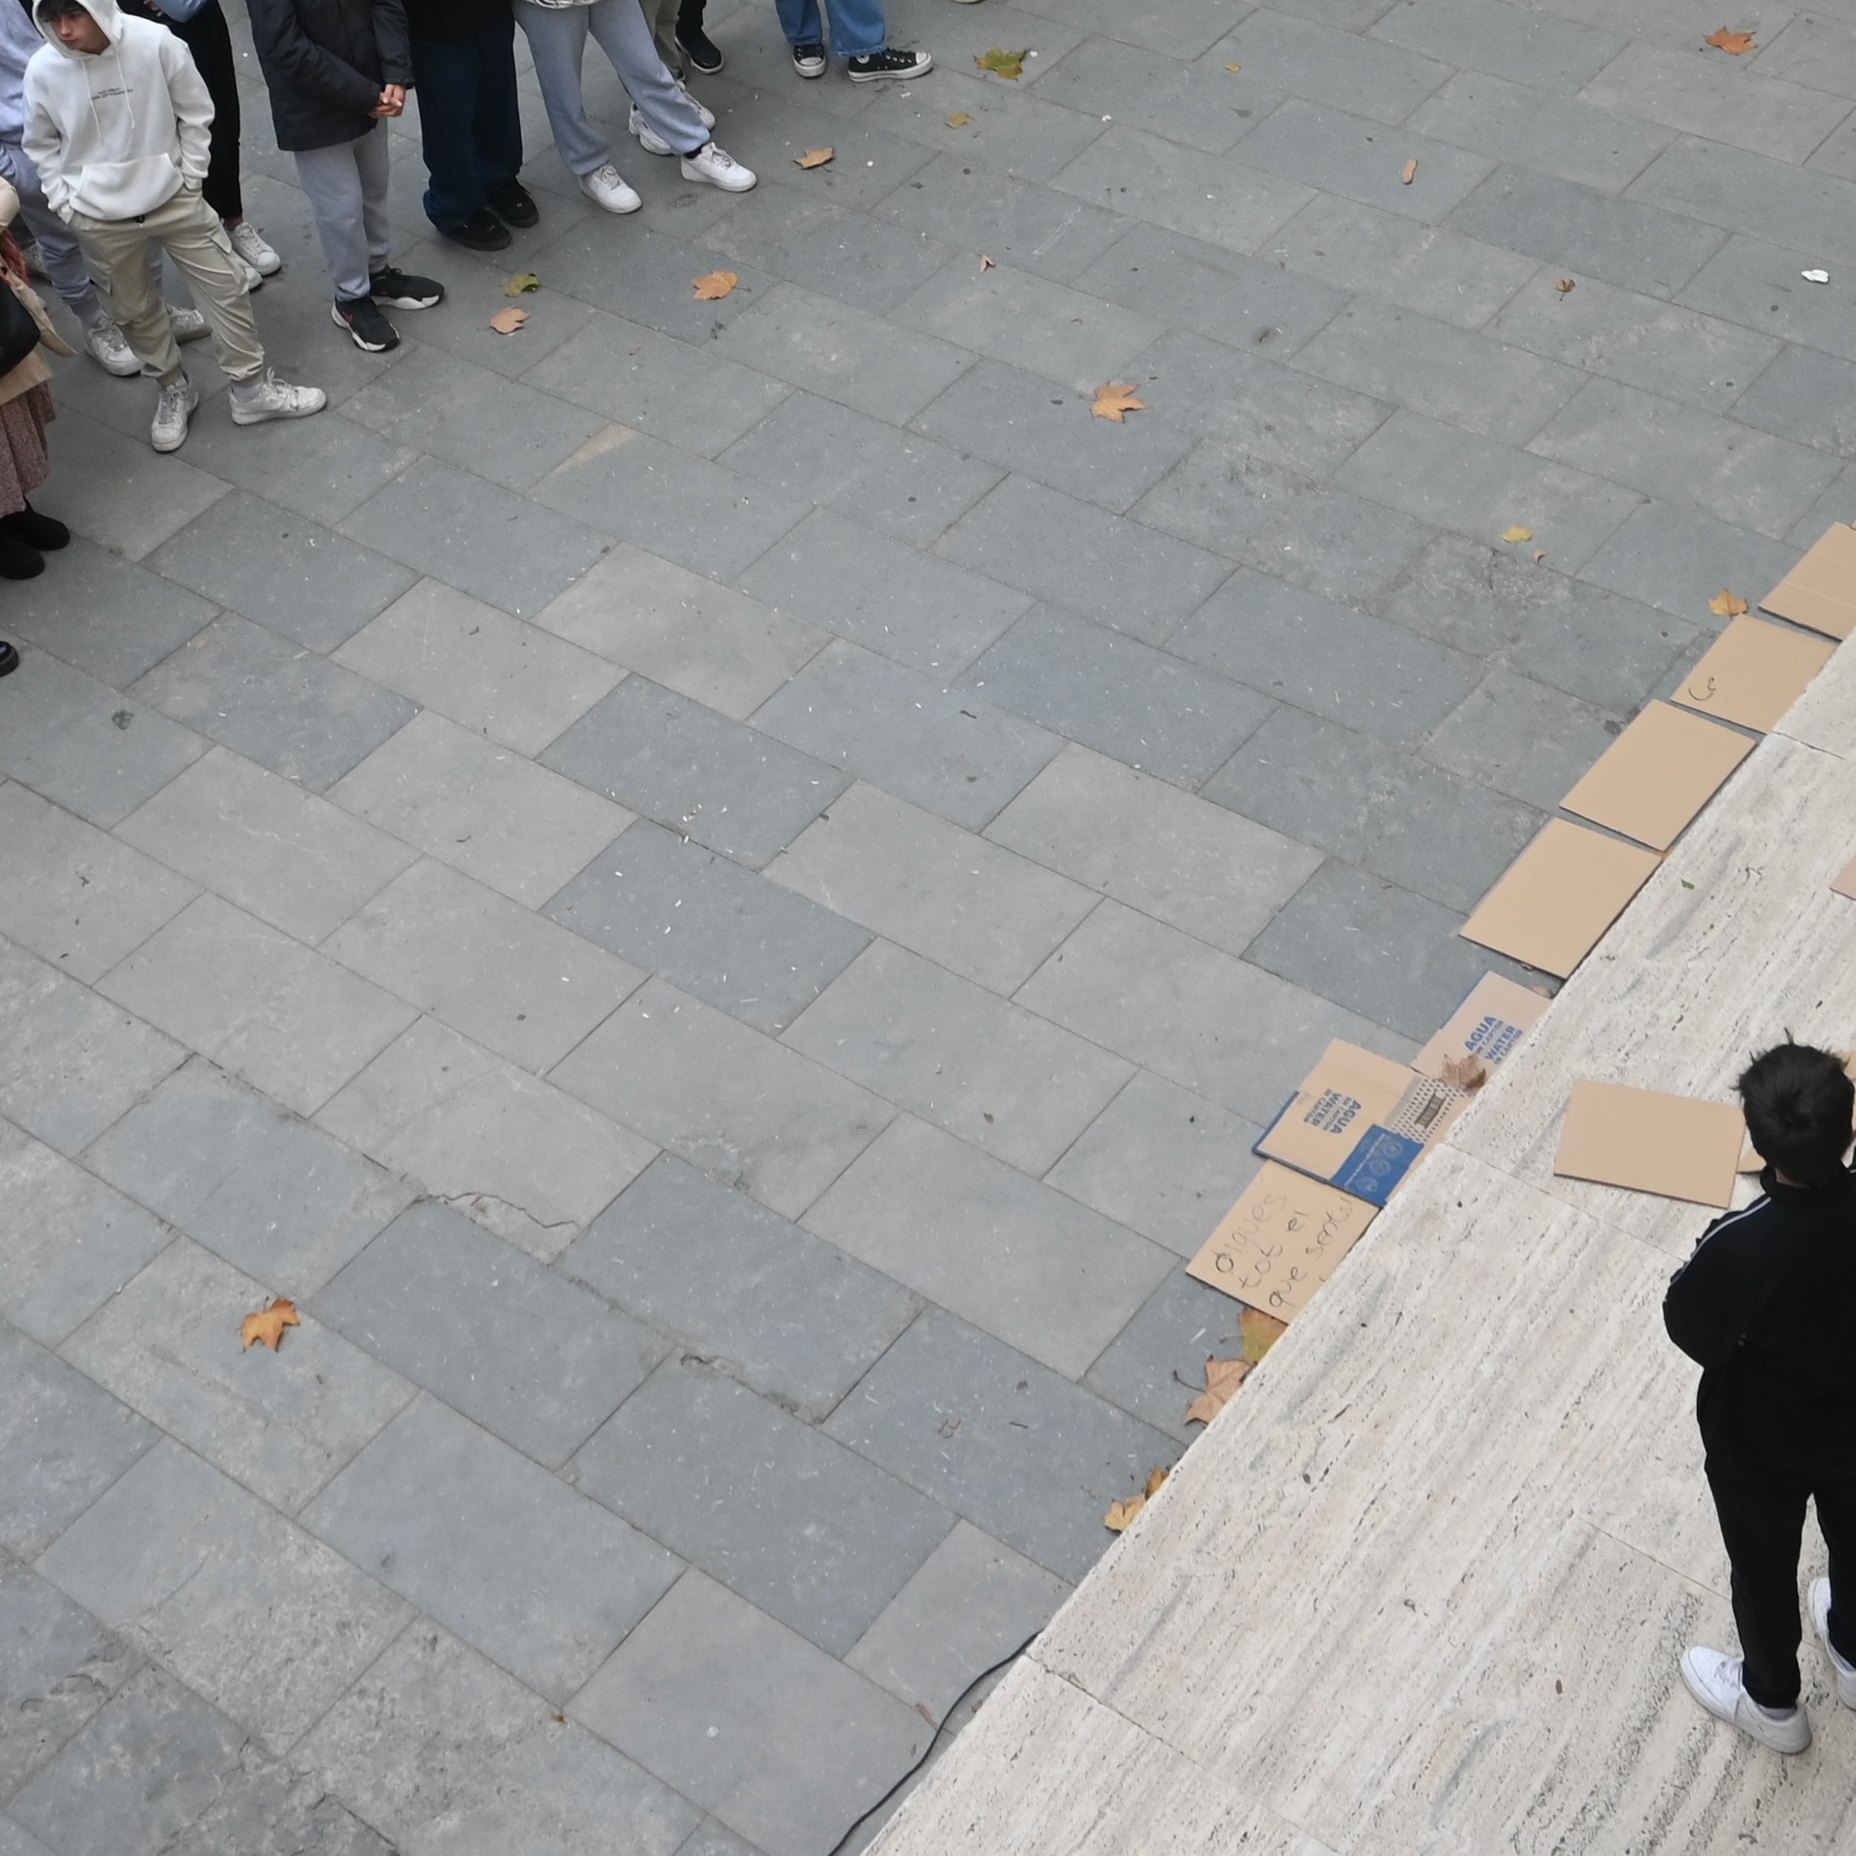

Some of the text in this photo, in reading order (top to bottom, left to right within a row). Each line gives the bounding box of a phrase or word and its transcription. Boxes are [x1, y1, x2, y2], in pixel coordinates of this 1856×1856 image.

[1464, 1015, 1497, 1052] AGUA
[1484, 1025, 1516, 1061] WATER
[1310, 1091, 1342, 1128] WATER
[1328, 1099, 1363, 1135] AGUA
